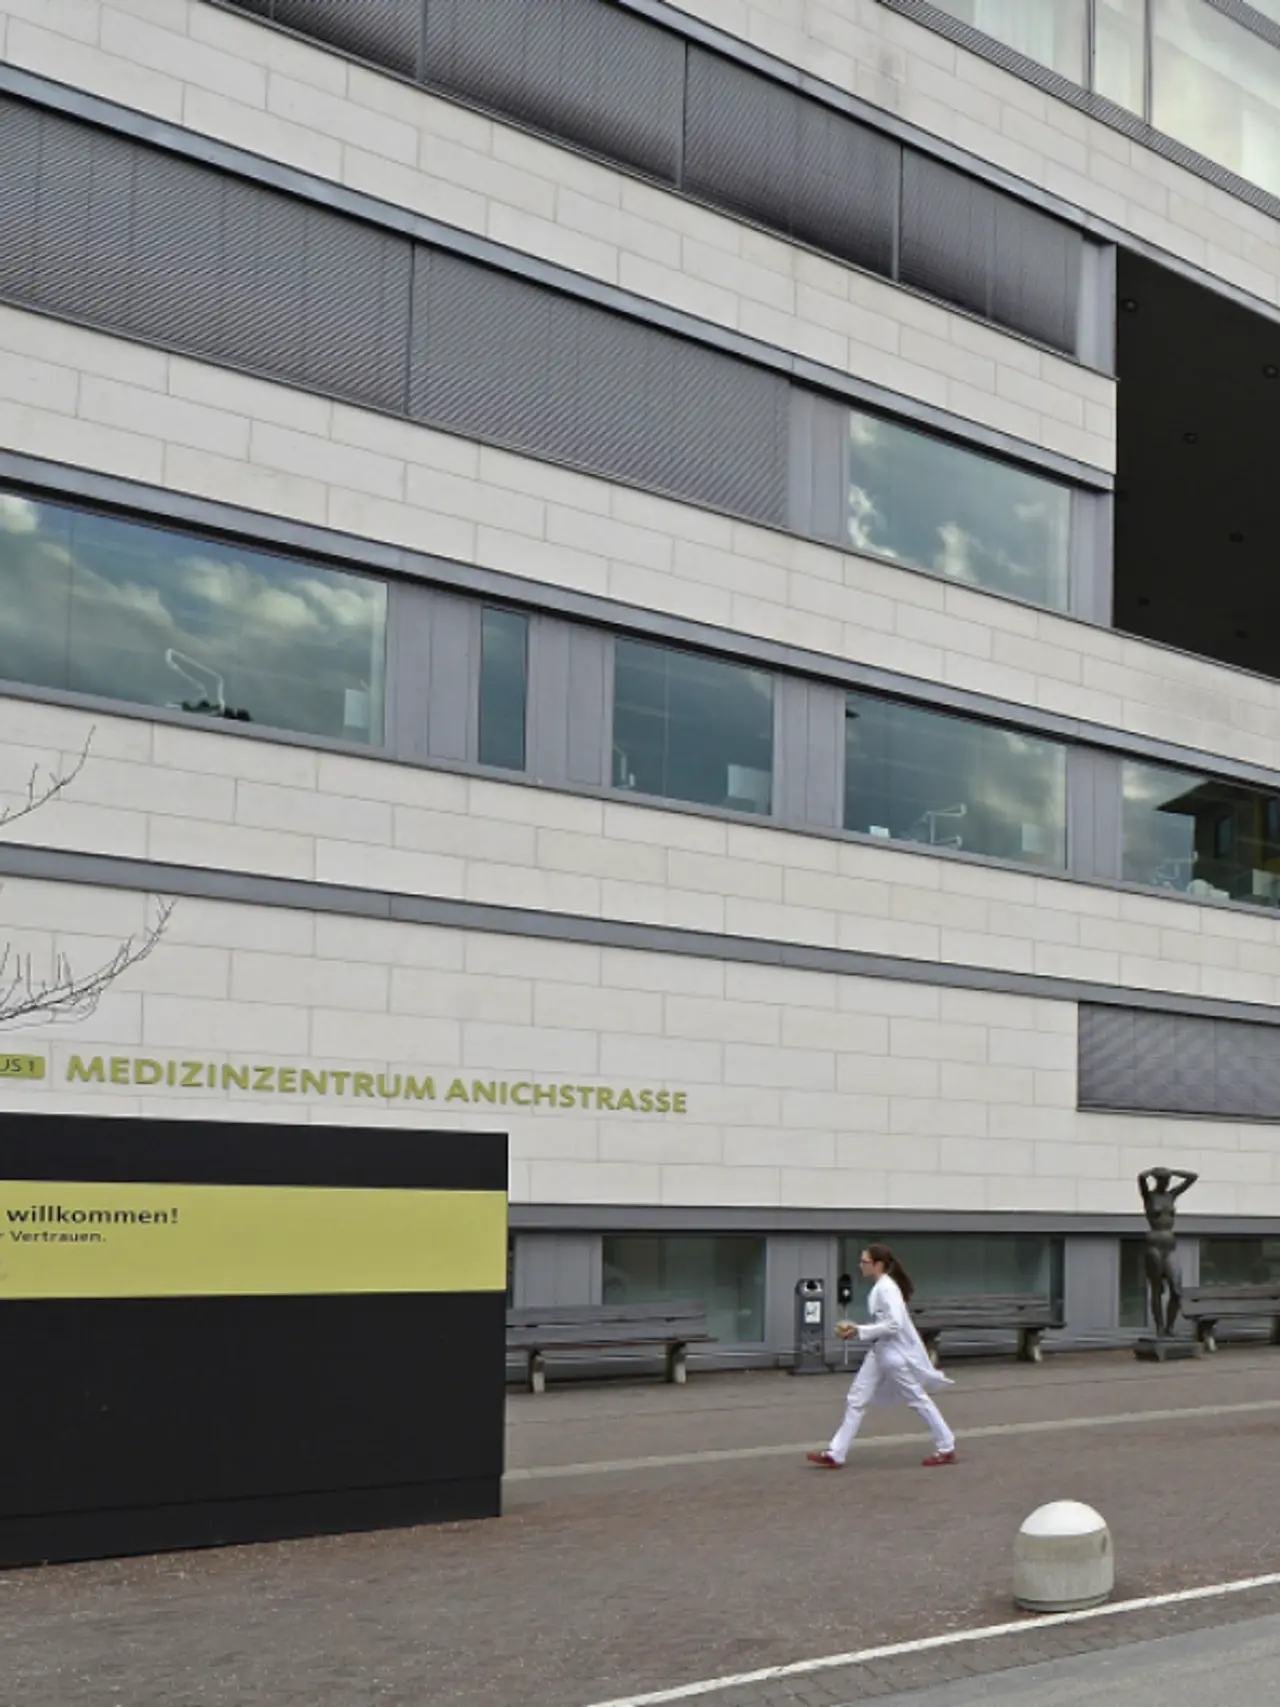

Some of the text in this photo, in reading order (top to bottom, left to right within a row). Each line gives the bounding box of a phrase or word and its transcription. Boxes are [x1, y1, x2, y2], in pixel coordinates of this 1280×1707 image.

[28, 1060, 35, 1072] 1
[66, 1054, 688, 1114] MEDIZINZENTRUM ANICHSTRASSE
[6, 1205, 178, 1224] willkommen!
[10, 1230, 107, 1243] Vertrauen.
